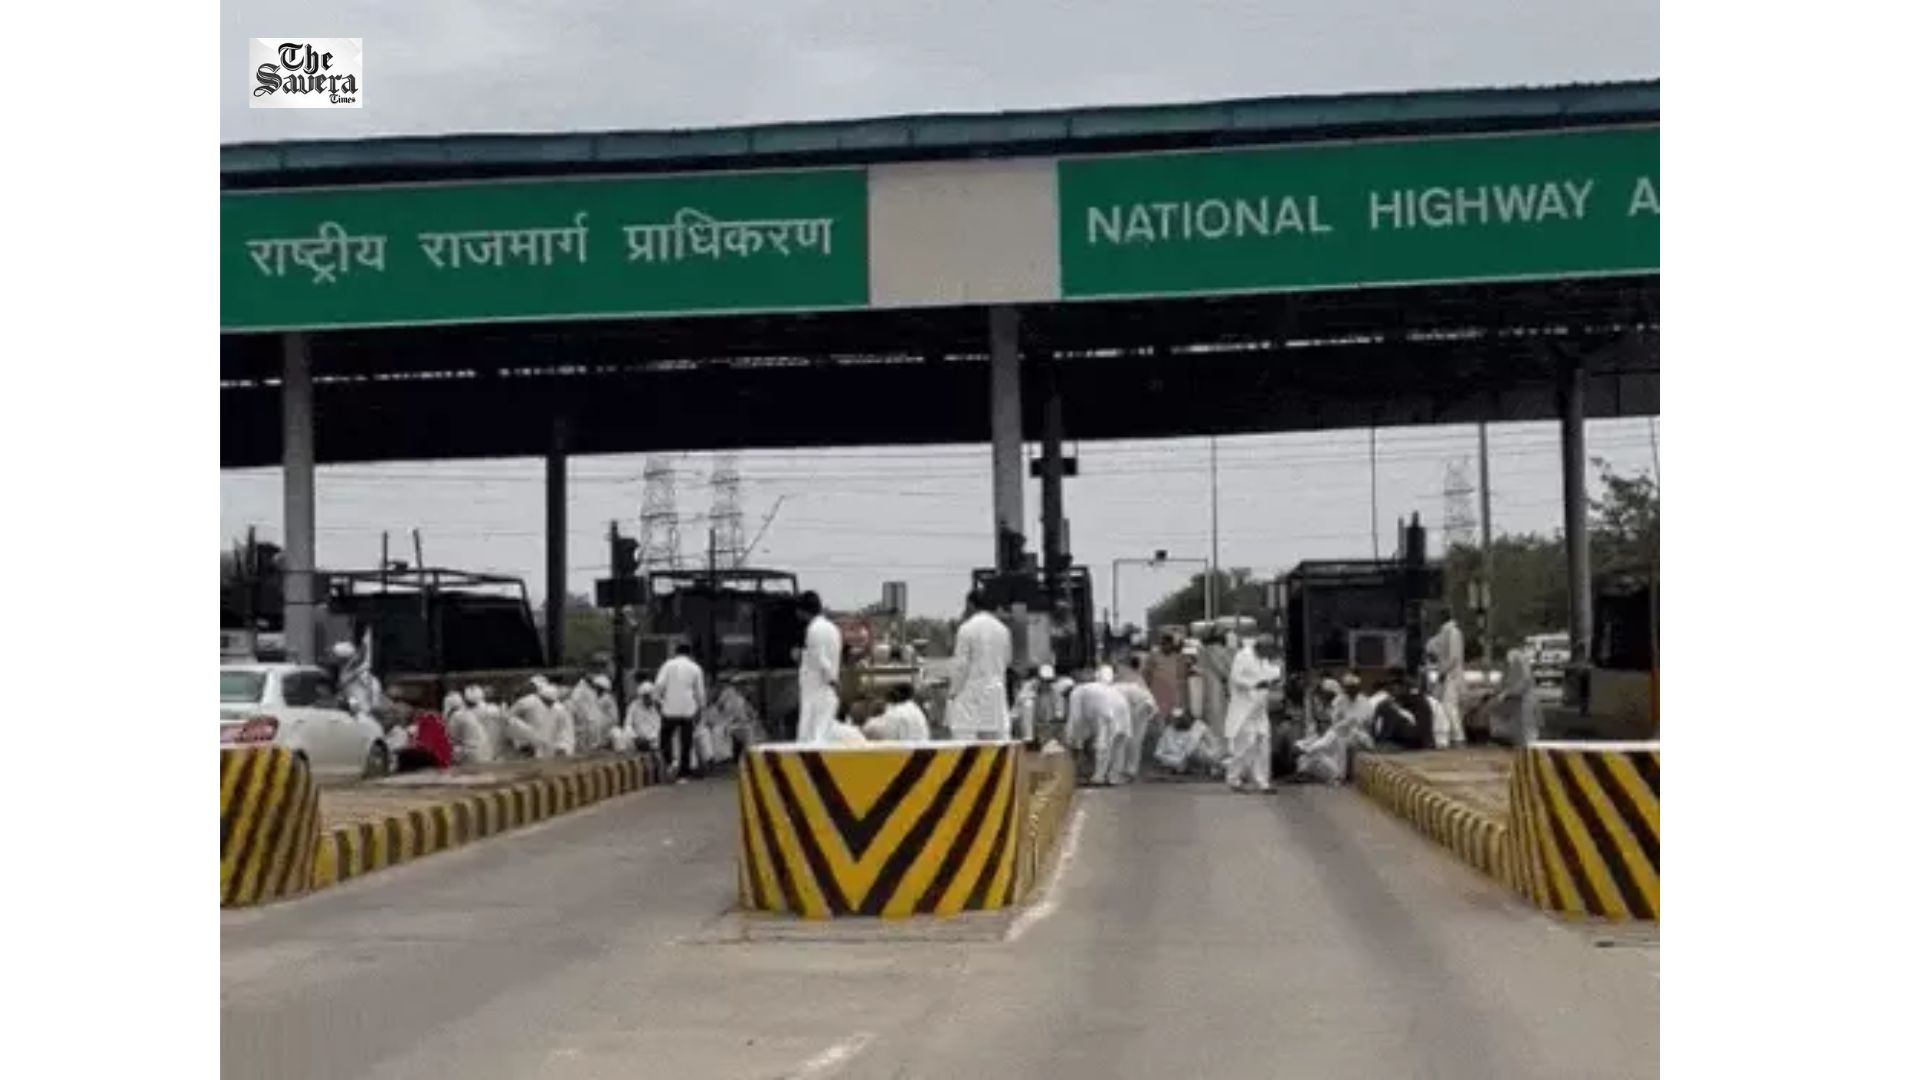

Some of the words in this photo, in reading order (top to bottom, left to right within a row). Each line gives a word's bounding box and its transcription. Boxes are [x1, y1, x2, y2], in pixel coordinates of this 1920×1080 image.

[247, 221, 387, 284] राष्ट्रीय
[419, 212, 589, 268] राजमार्ग
[623, 207, 834, 262] प्राधिकरण
[1087, 196, 1333, 245] NATIONAL
[1370, 179, 1594, 230] HIGHWAY
